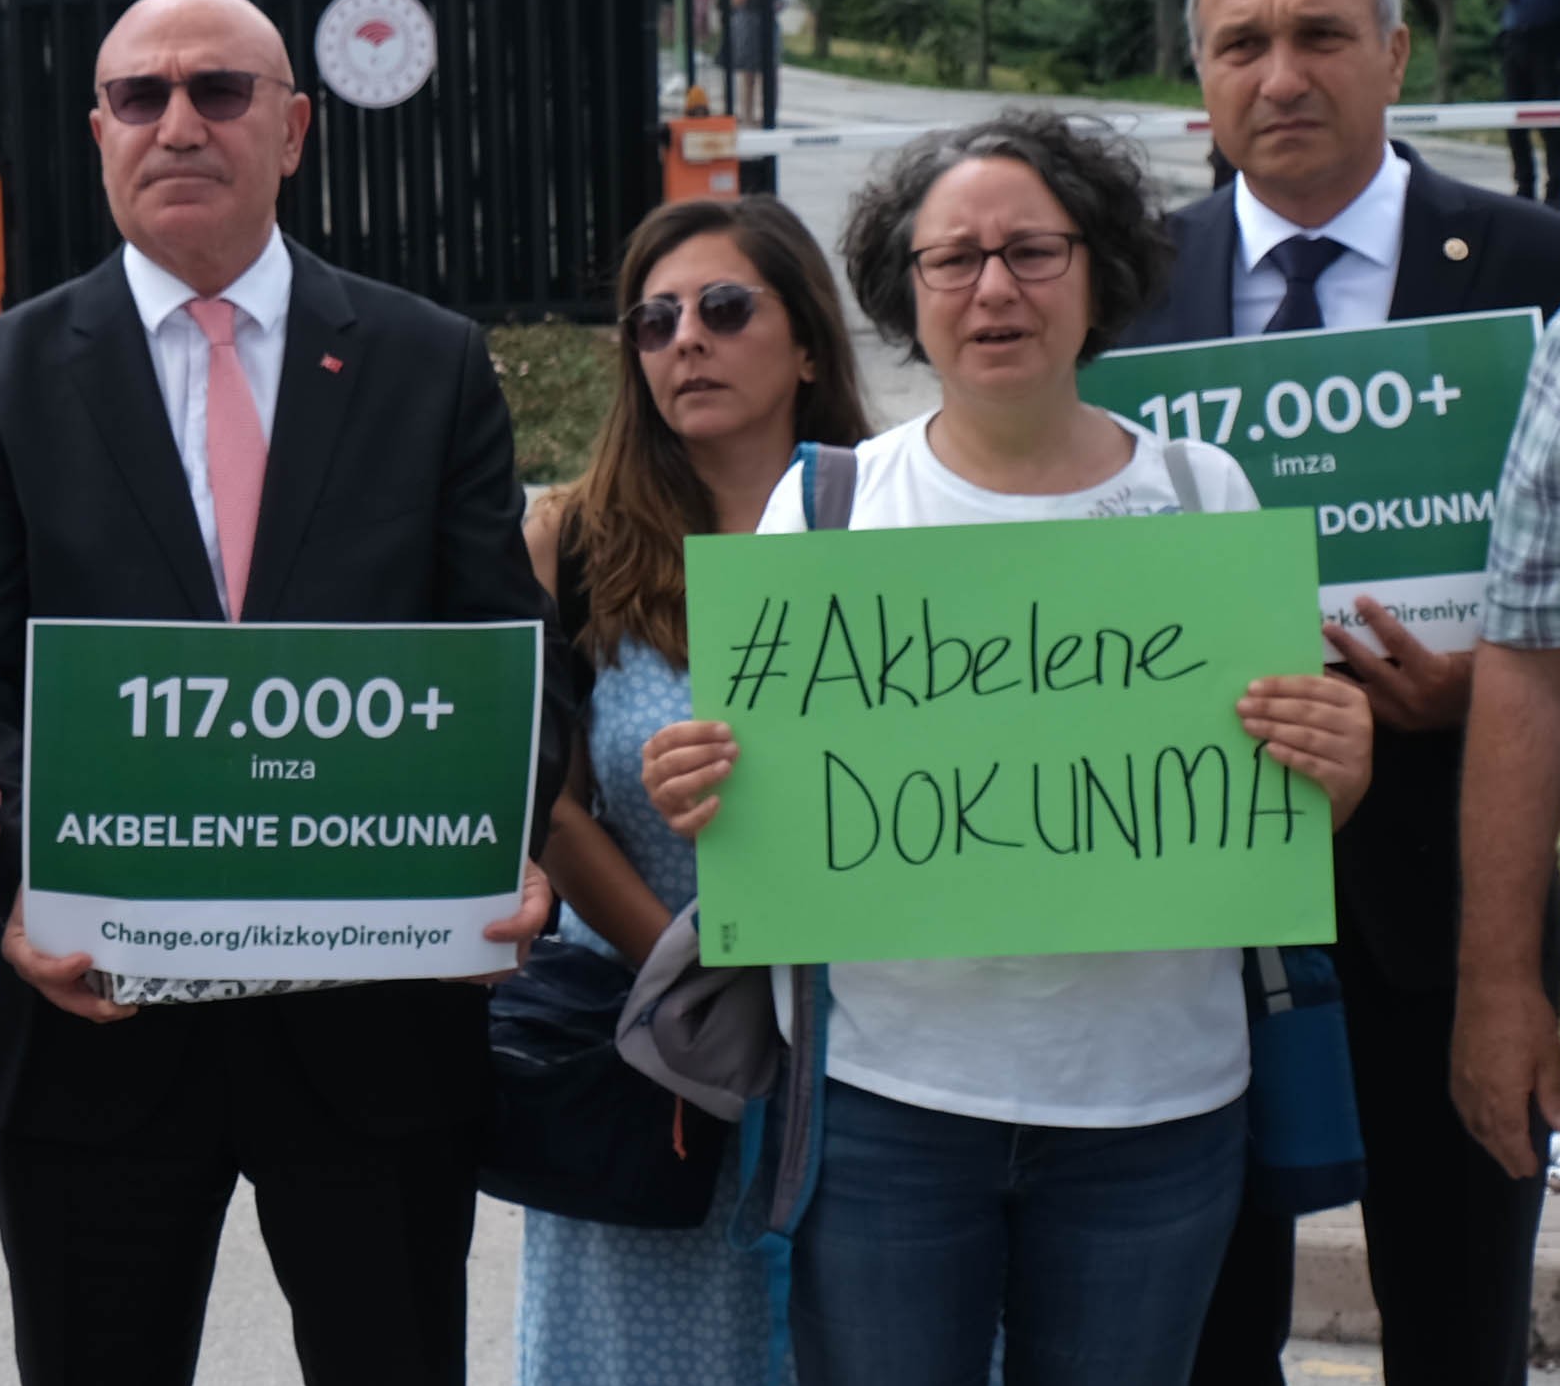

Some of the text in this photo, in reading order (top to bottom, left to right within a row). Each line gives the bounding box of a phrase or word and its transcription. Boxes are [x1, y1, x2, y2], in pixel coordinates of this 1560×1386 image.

[1138, 370, 1461, 446] 117.000+
[1272, 452, 1337, 478] imza
[1319, 489, 1496, 537] DOKUNM
[725, 593, 1207, 716] #Akbelene
[117, 675, 455, 740] 117.000+
[250, 754, 316, 781] imza
[823, 740, 1307, 871] DOKUNMA
[55, 814, 498, 848] AKBELEN'E DOKUNMA
[100, 920, 453, 953] Change.org/ikizkoyDireniyor
